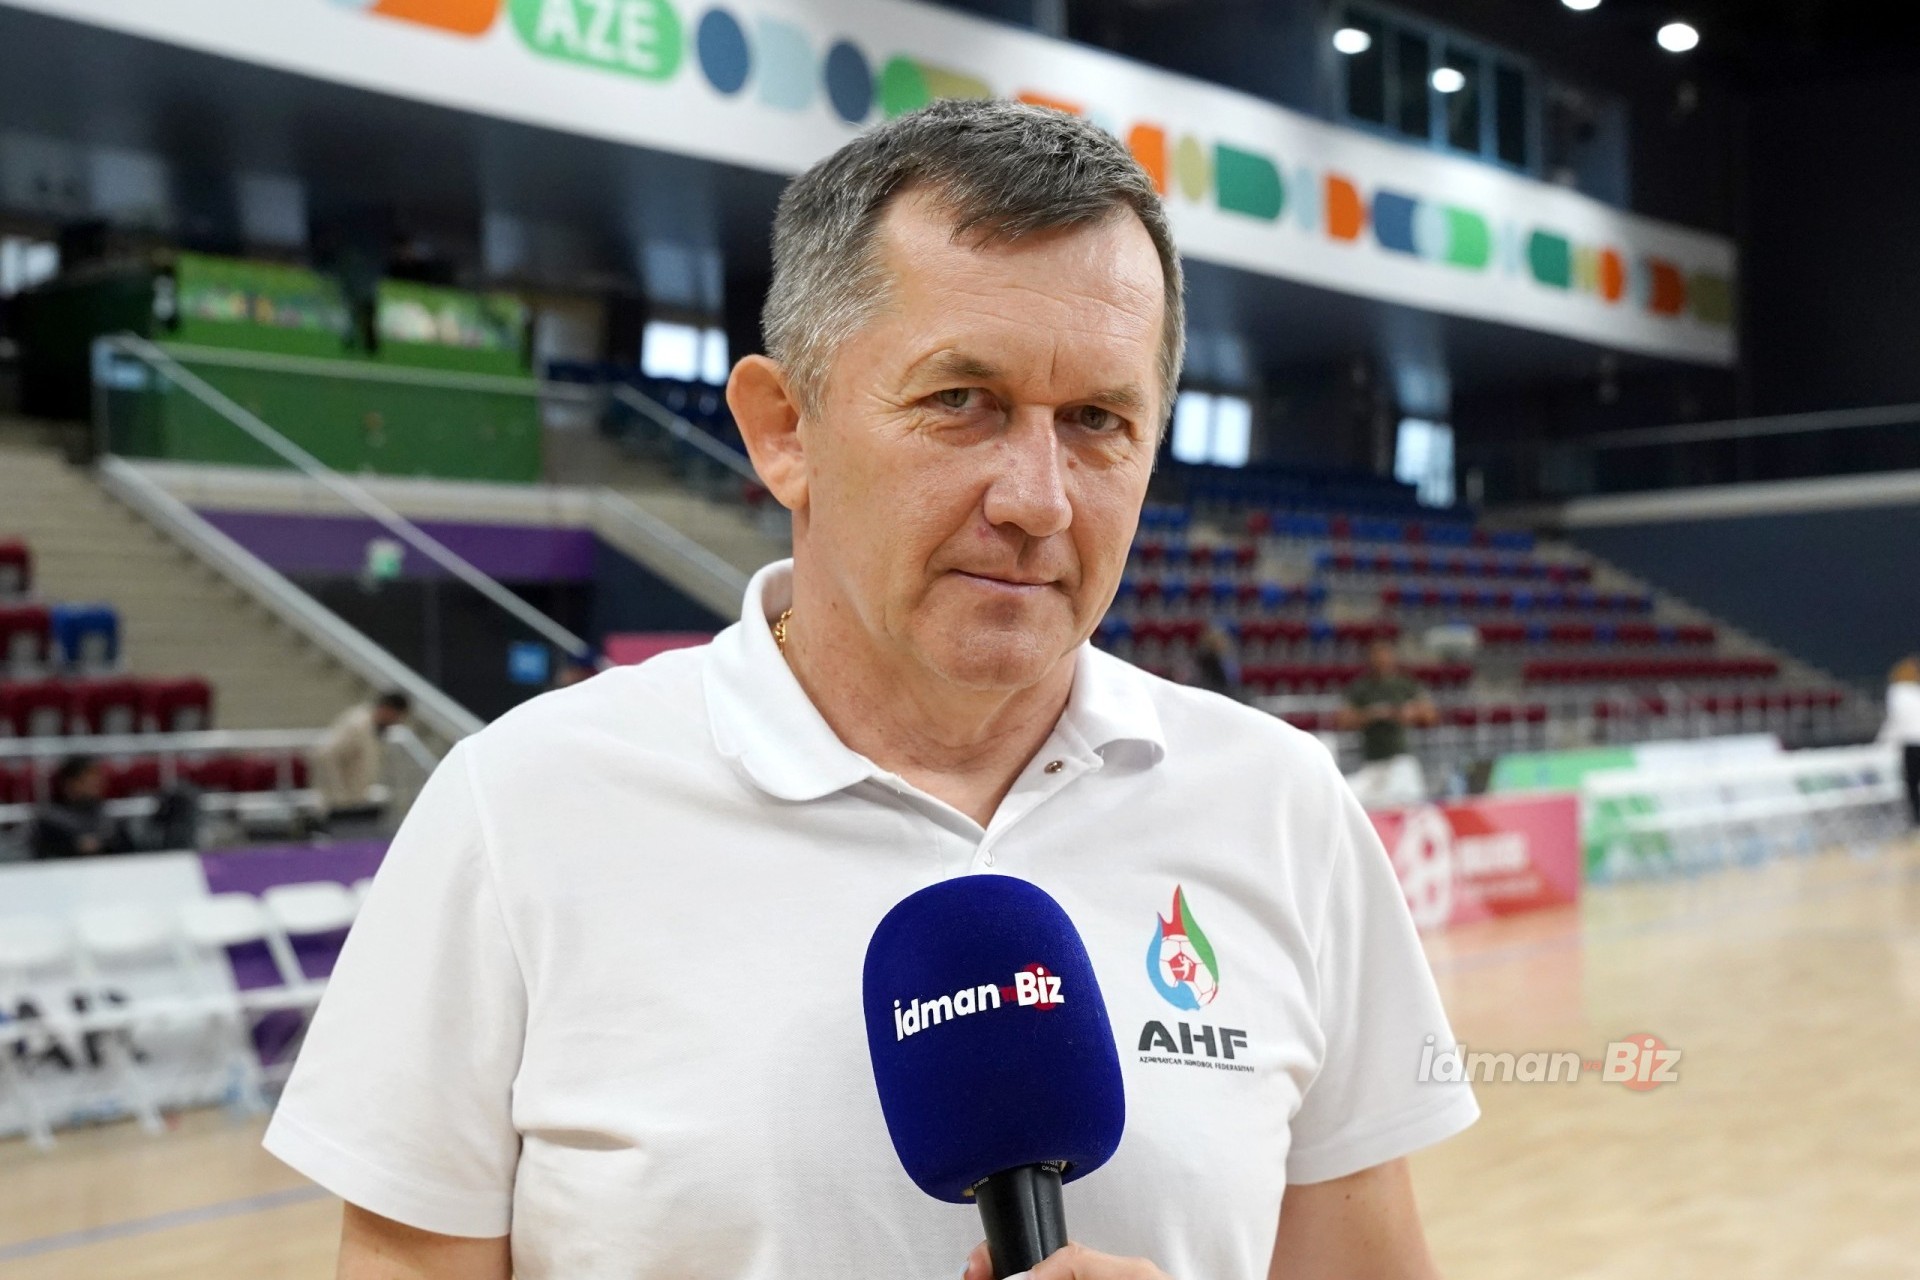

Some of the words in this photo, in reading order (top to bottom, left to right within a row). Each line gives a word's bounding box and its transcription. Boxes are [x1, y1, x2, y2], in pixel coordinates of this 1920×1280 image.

[536, 0, 659, 70] AZE
[1014, 967, 1065, 1006] Biz
[1138, 1020, 1247, 1059] AHF
